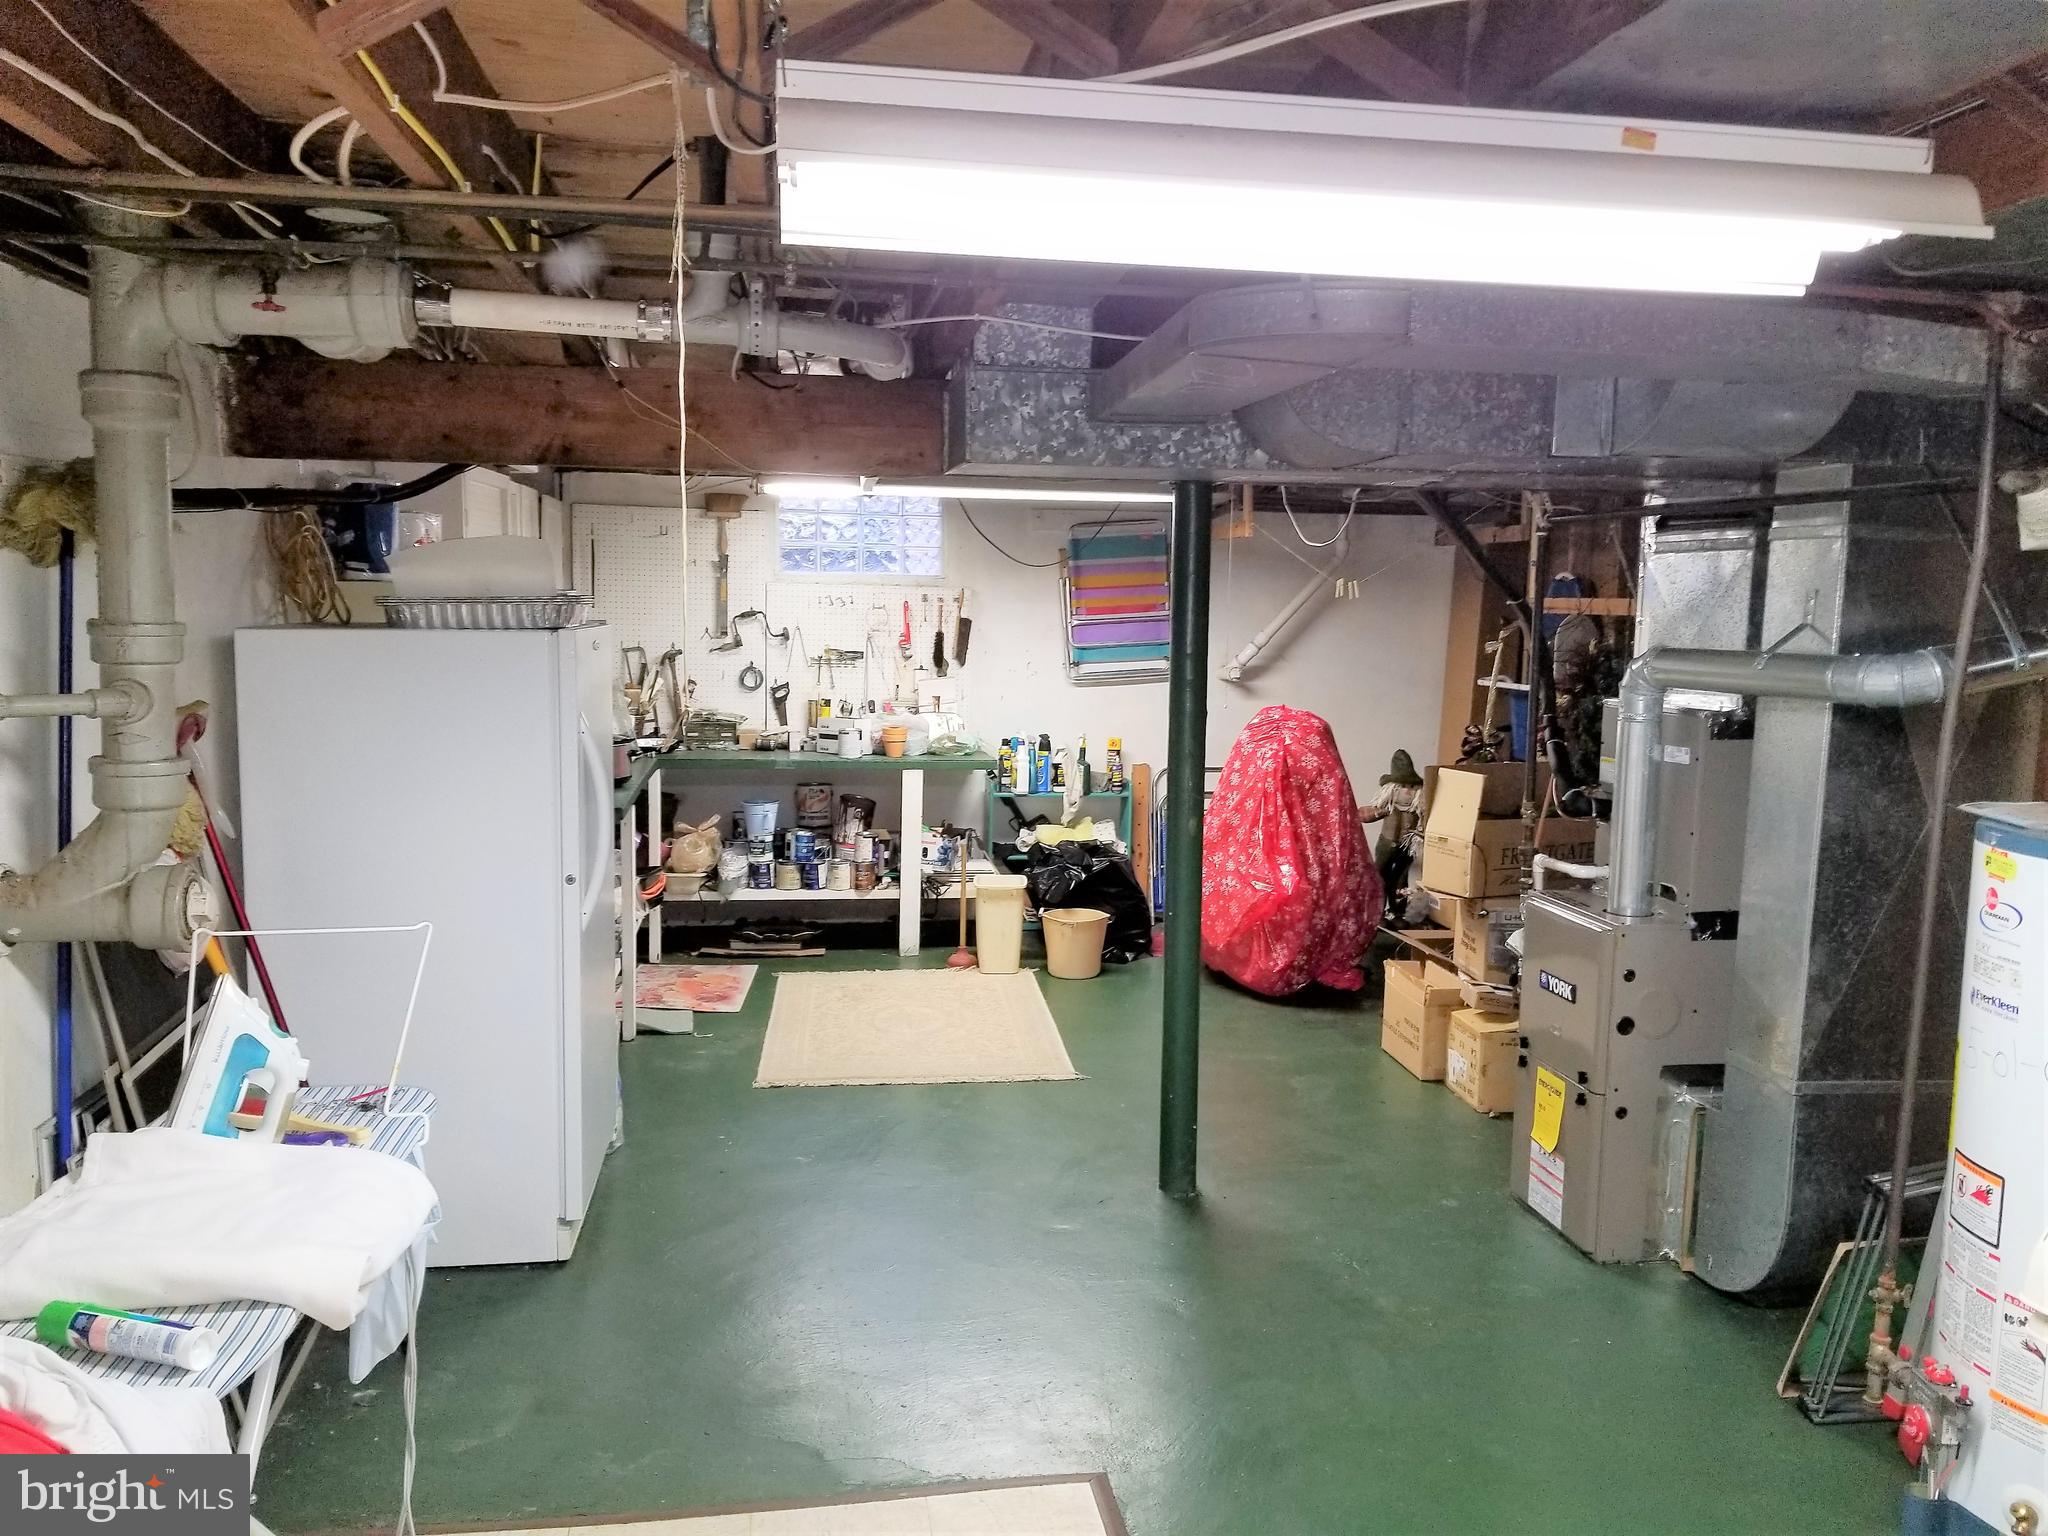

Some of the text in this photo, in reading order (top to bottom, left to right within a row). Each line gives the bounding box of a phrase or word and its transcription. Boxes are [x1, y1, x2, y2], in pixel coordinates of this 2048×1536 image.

[1500, 841, 1595, 866] FRTGATE
[1548, 975, 1573, 1001] YORK
[1975, 989, 2019, 1015] EverKleen
